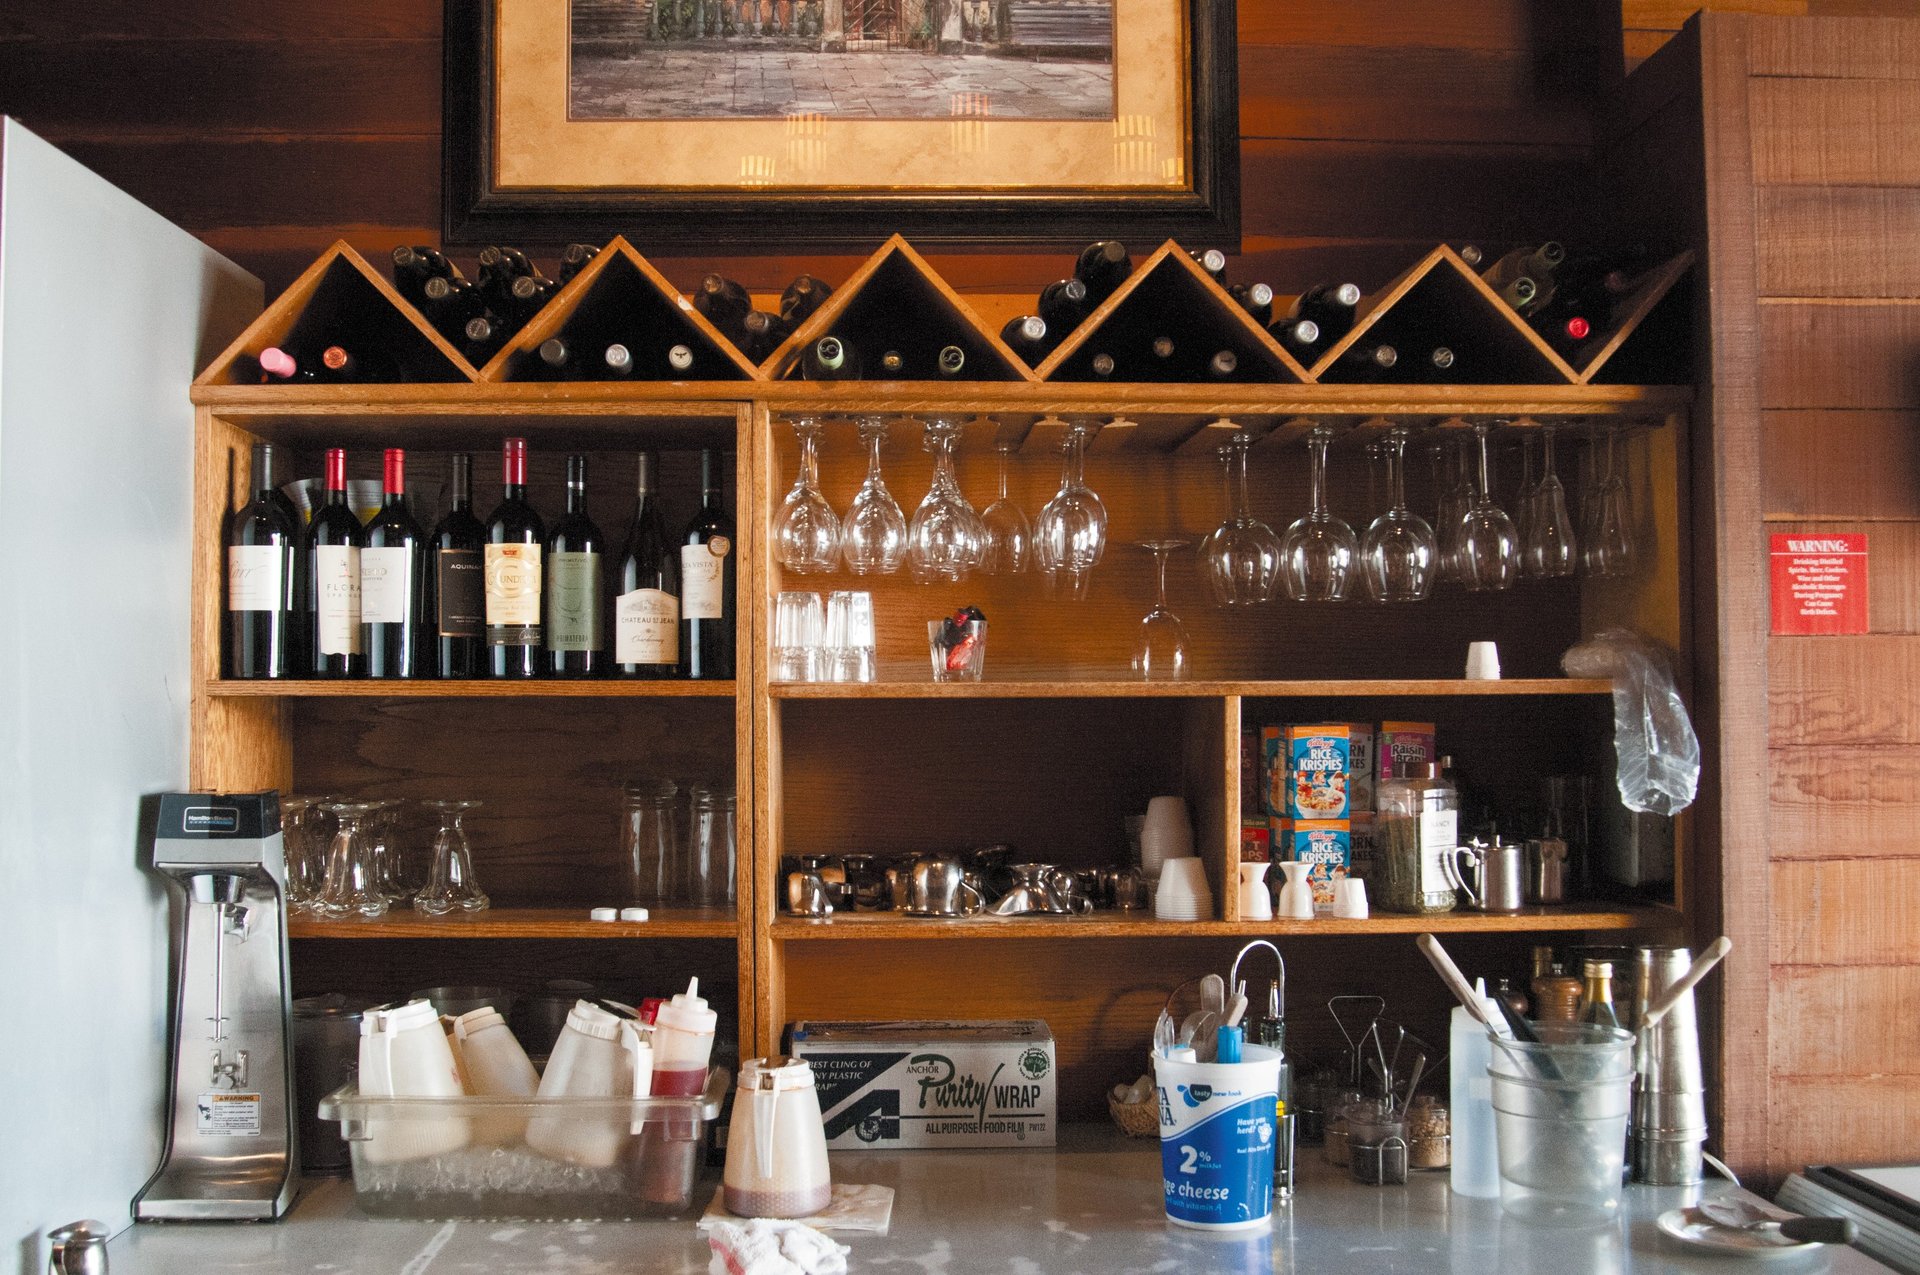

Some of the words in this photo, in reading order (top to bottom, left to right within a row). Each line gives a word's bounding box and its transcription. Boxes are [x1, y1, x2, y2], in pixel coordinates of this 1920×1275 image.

[1787, 540, 1849, 552] WARNING:
[621, 617, 652, 625] CHATEAU
[660, 617, 675, 625] JEAN
[1310, 749, 1332, 760] RICE
[1349, 745, 1365, 757] RN
[1391, 743, 1426, 756] Raisin
[1299, 759, 1343, 771] KRISPIES
[1311, 842, 1333, 853] RICE
[1351, 836, 1374, 849] ORN
[1300, 852, 1344, 864] KRISPIES
[809, 1060, 829, 1069] BEST
[829, 1060, 857, 1069] CLING
[859, 1060, 872, 1069] OF
[905, 1066, 940, 1074] ANCHOR
[815, 1072, 827, 1080] NY
[828, 1071, 864, 1080] PLASTIC
[910, 1053, 1005, 1133] Purity
[993, 1084, 1041, 1109] WRAP
[1194, 1089, 1211, 1098] tasty
[1236, 1118, 1255, 1126] Have
[1255, 1116, 1266, 1126] you
[925, 1122, 941, 1134] ALL
[941, 1122, 979, 1134] PURPOSE
[983, 1122, 1006, 1134] FOOD
[1006, 1121, 1025, 1134] FILM
[1028, 1122, 1046, 1132] PW122
[1178, 1180, 1230, 1201] cheese
[1185, 1200, 1213, 1212] vitamin
